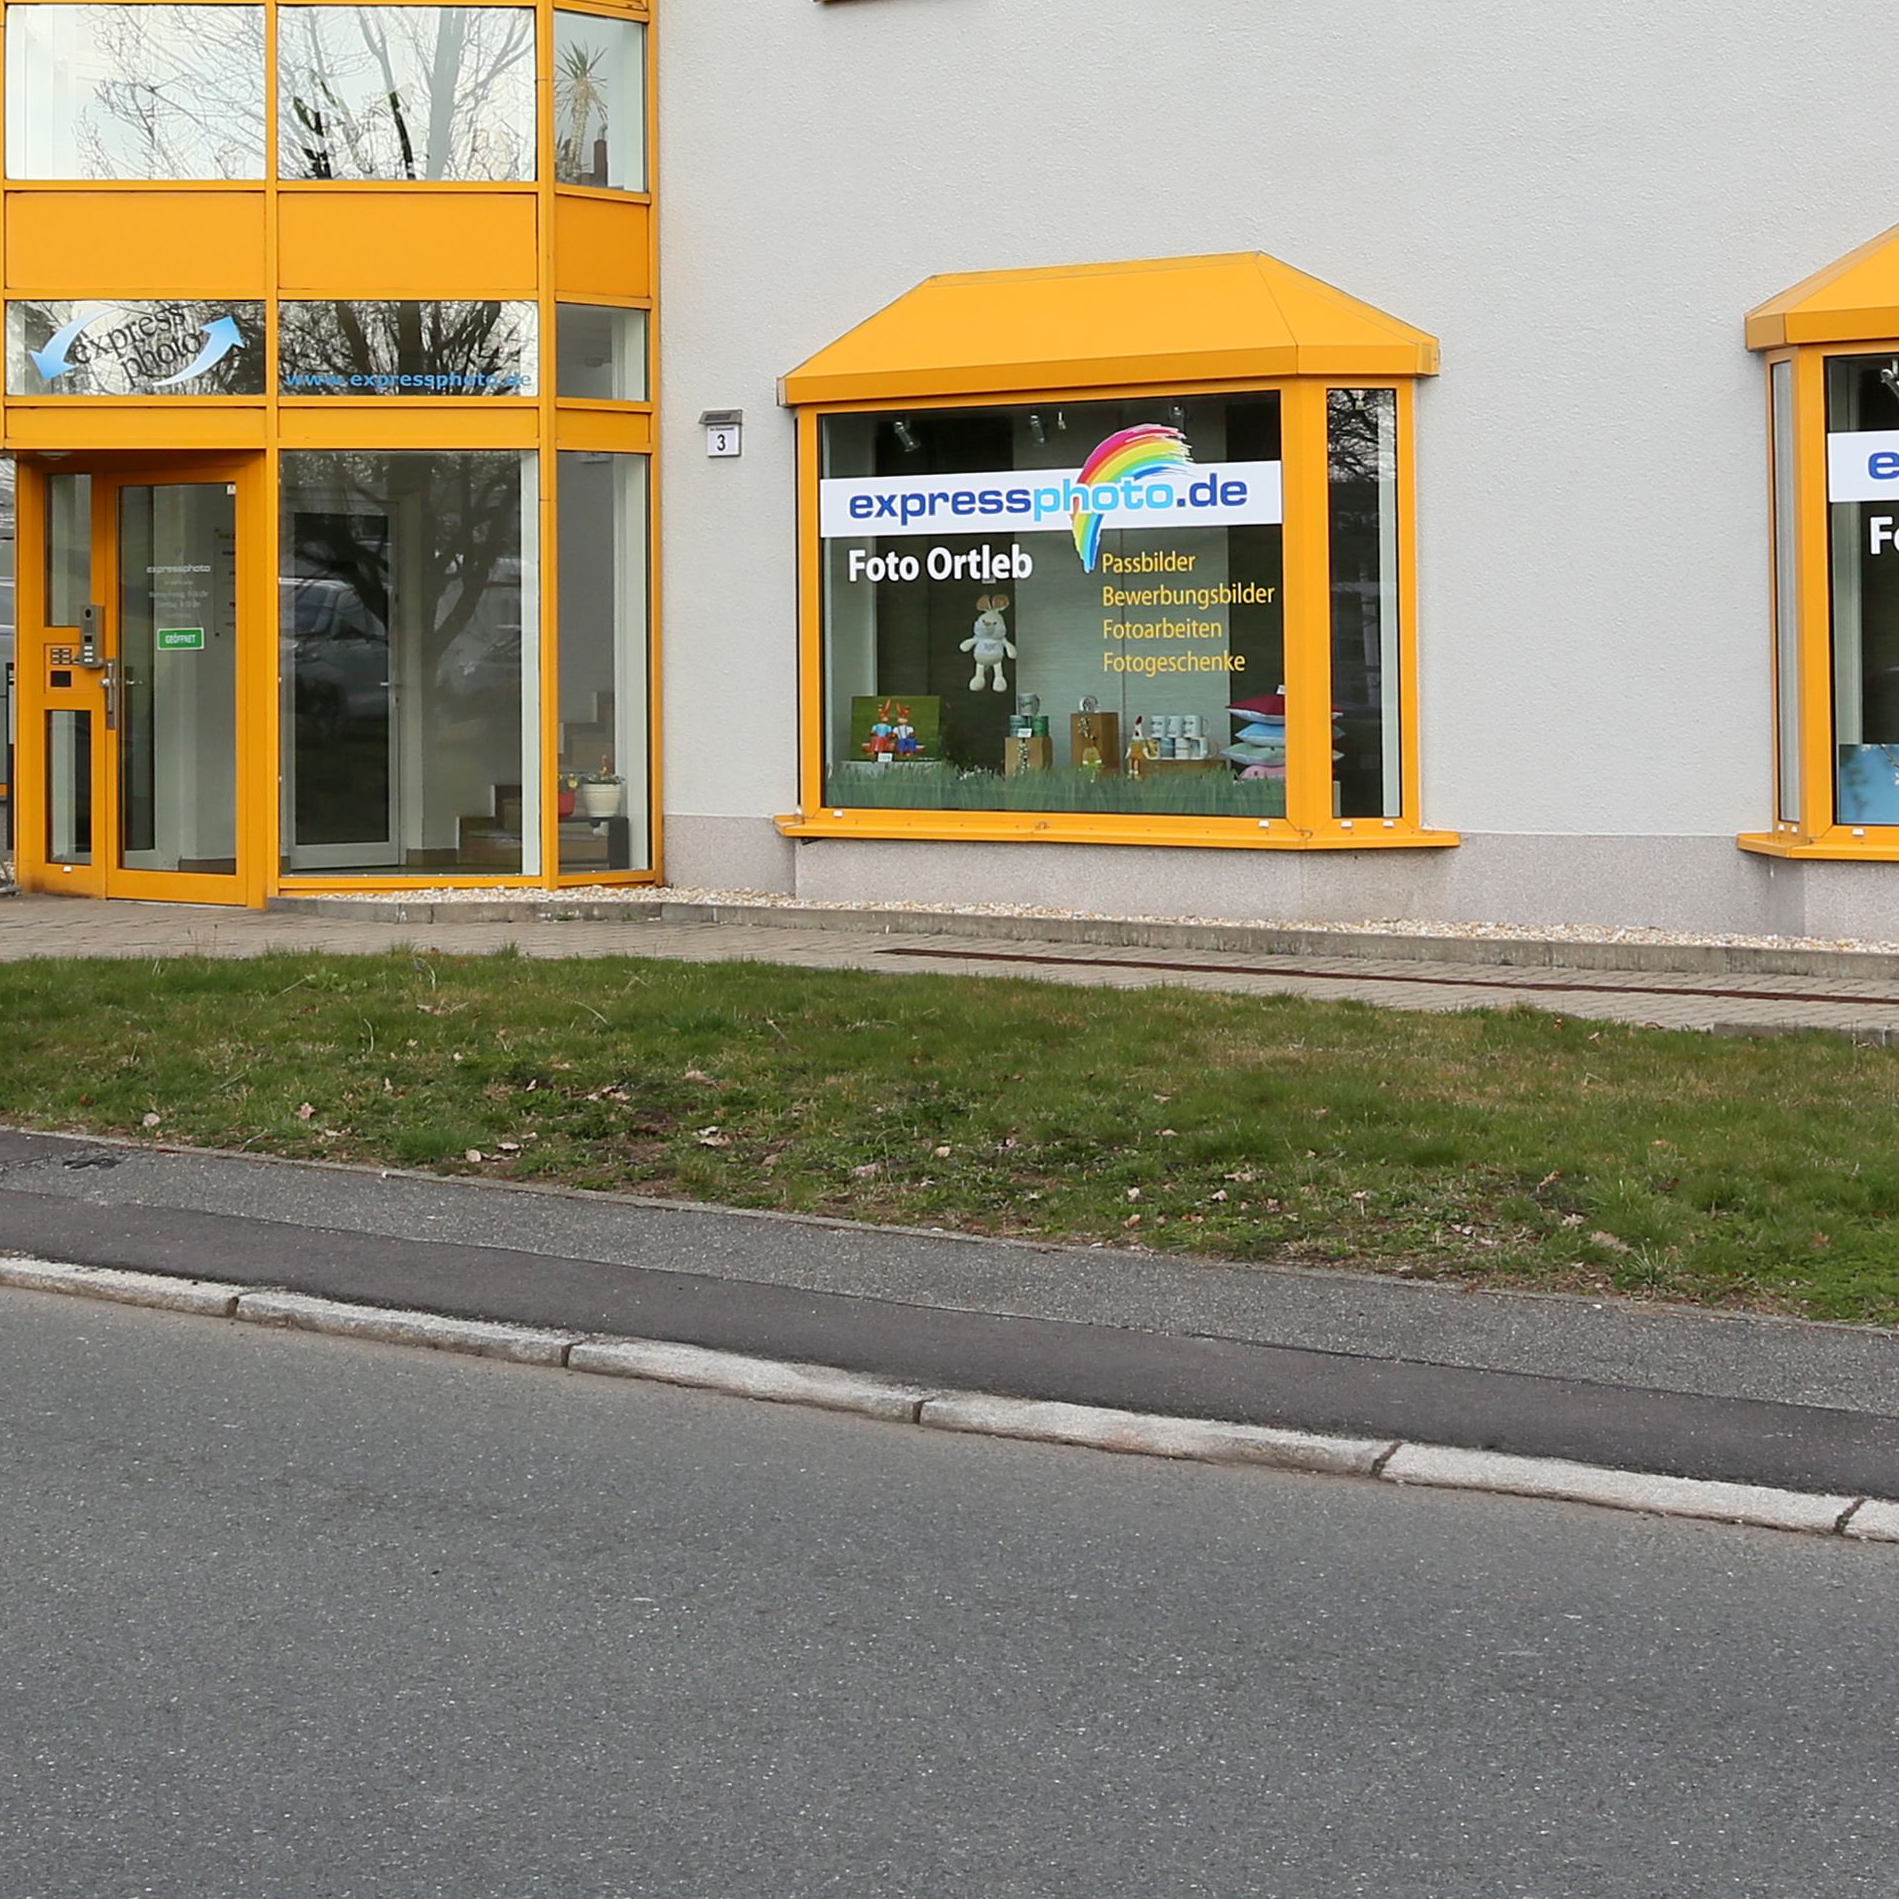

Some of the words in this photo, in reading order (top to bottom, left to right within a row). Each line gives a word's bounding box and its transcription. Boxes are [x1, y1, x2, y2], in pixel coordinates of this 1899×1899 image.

[74, 304, 186, 365] express
[120, 331, 201, 388] photo
[286, 371, 532, 390] www.expressphoto.de
[716, 433, 726, 452] 3
[849, 473, 1249, 526] expressphoto.de
[848, 548, 920, 583] Foto
[926, 544, 1034, 580] Ortleb
[1102, 550, 1196, 574] Passbilder
[1102, 582, 1276, 610] Bewerbungsbilder
[1103, 617, 1222, 640] Fotoarbeiten
[1103, 650, 1246, 677] Fotogeschenke
